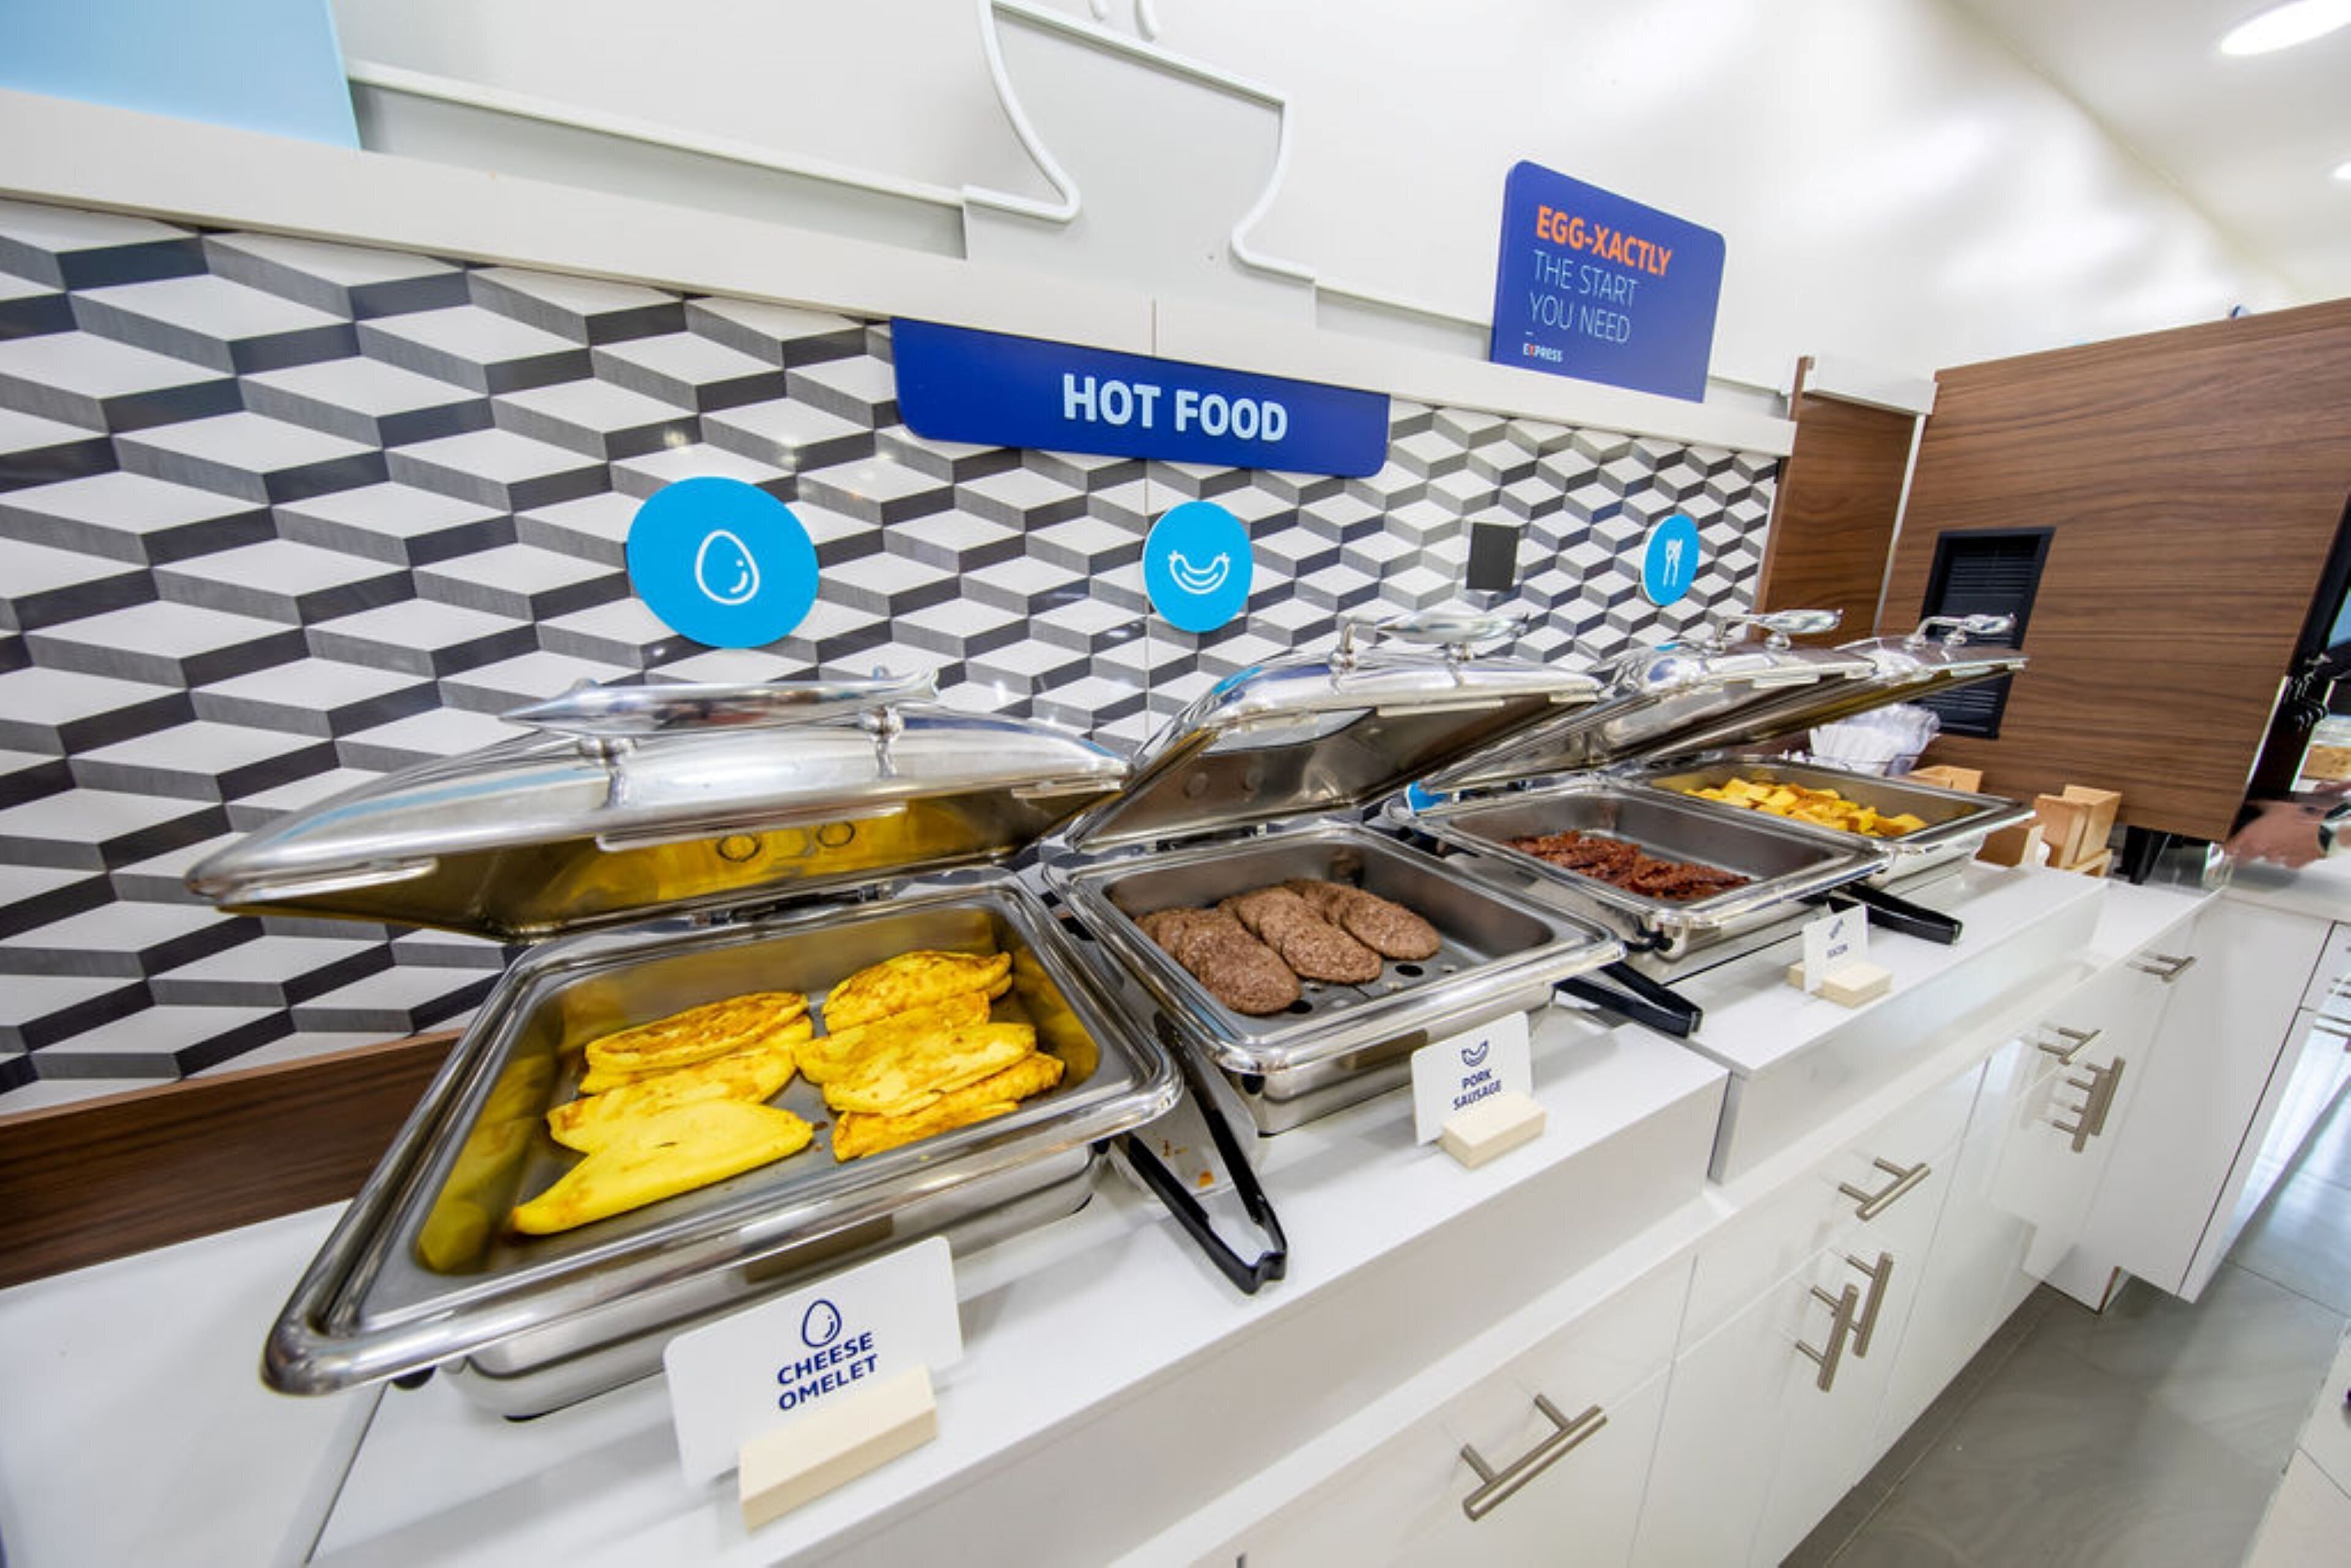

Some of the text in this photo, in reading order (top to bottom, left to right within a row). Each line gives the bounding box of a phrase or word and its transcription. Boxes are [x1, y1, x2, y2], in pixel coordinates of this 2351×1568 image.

[1537, 204, 1673, 276] EGG-XACTLY
[1534, 249, 1640, 307] THE START
[1529, 292, 1631, 343] YOU NEED
[1063, 373, 1288, 441] HOT FOOD
[1453, 1079, 1502, 1110] SAUSAGE
[1462, 1068, 1492, 1089] PORK
[777, 1331, 874, 1386] CHEESE
[778, 1353, 879, 1411] OMELET
